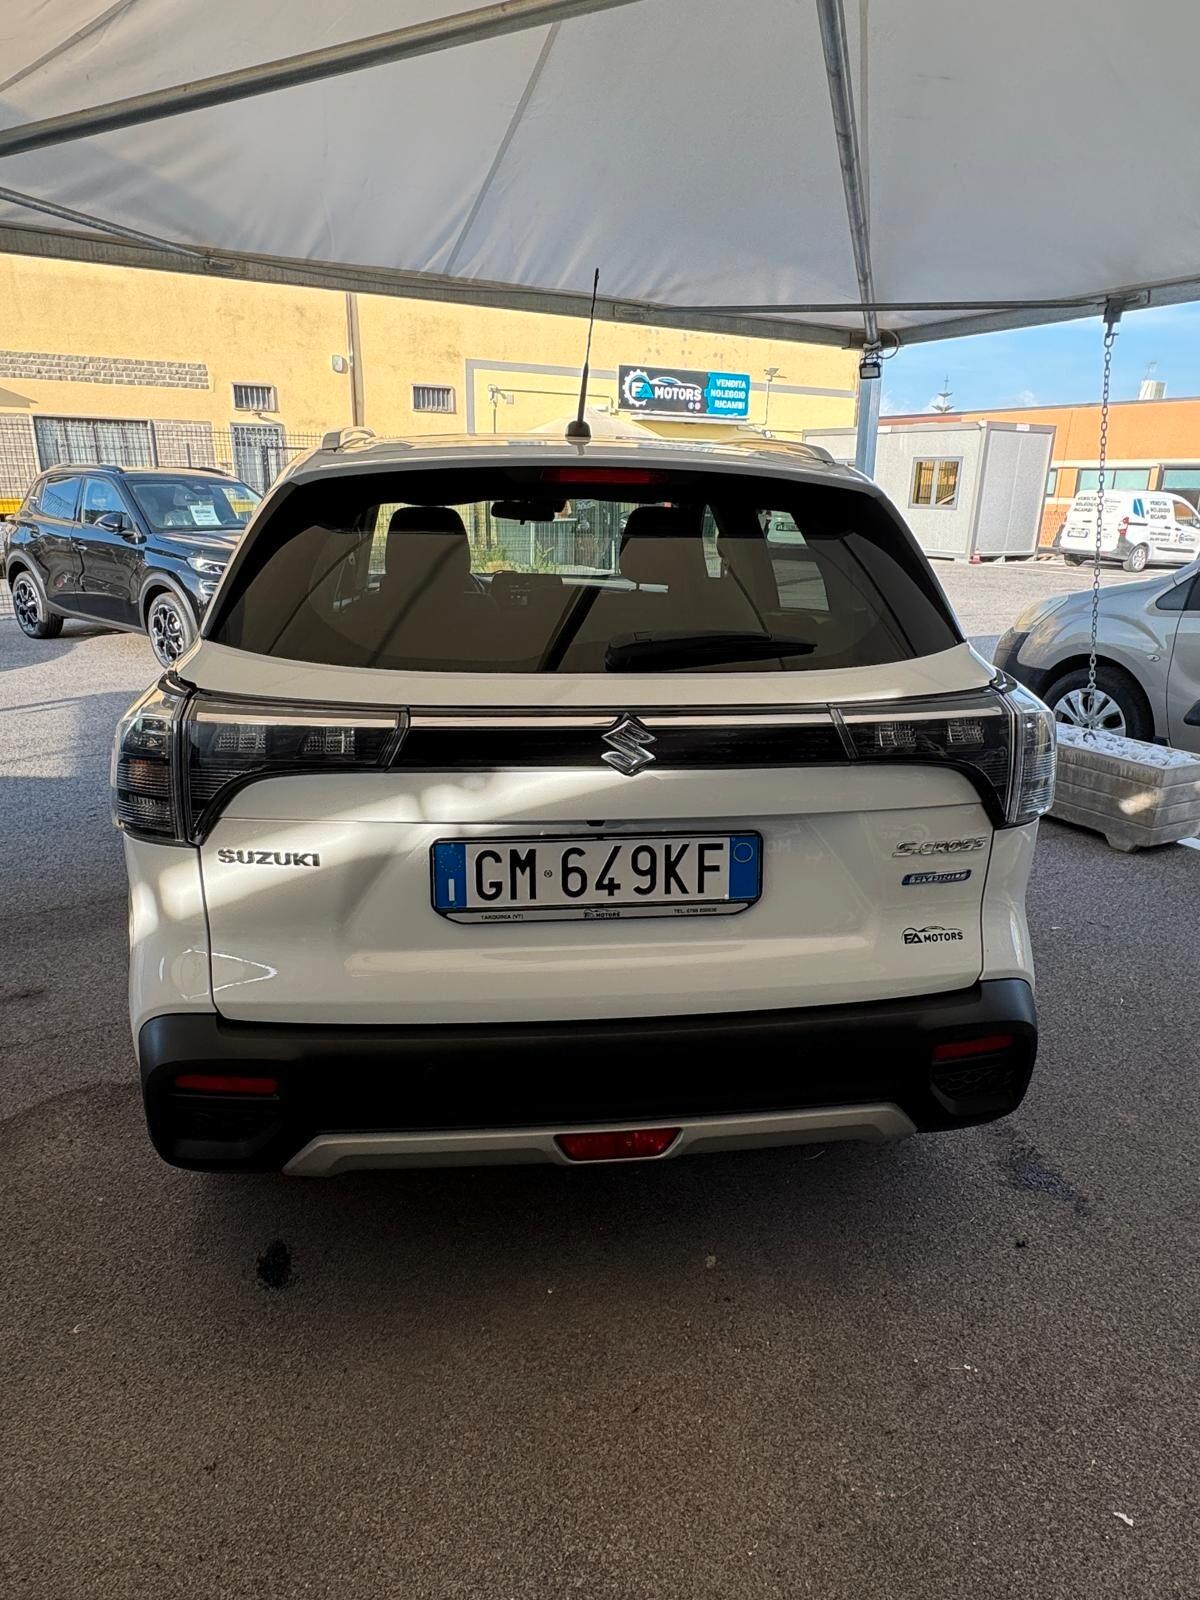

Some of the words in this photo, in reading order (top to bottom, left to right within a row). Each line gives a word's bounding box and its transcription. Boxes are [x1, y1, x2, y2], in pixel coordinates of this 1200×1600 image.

[716, 379, 746, 389] VENDITA
[654, 386, 702, 402] MOTORS
[710, 389, 746, 399] NOLEGGIO
[714, 400, 745, 410] RICAMBI
[893, 837, 987, 857] S-CROSS
[217, 848, 321, 867] SUZUKI
[475, 848, 537, 901] GM
[561, 843, 724, 898] 649KF
[924, 932, 964, 943] MOTORS
